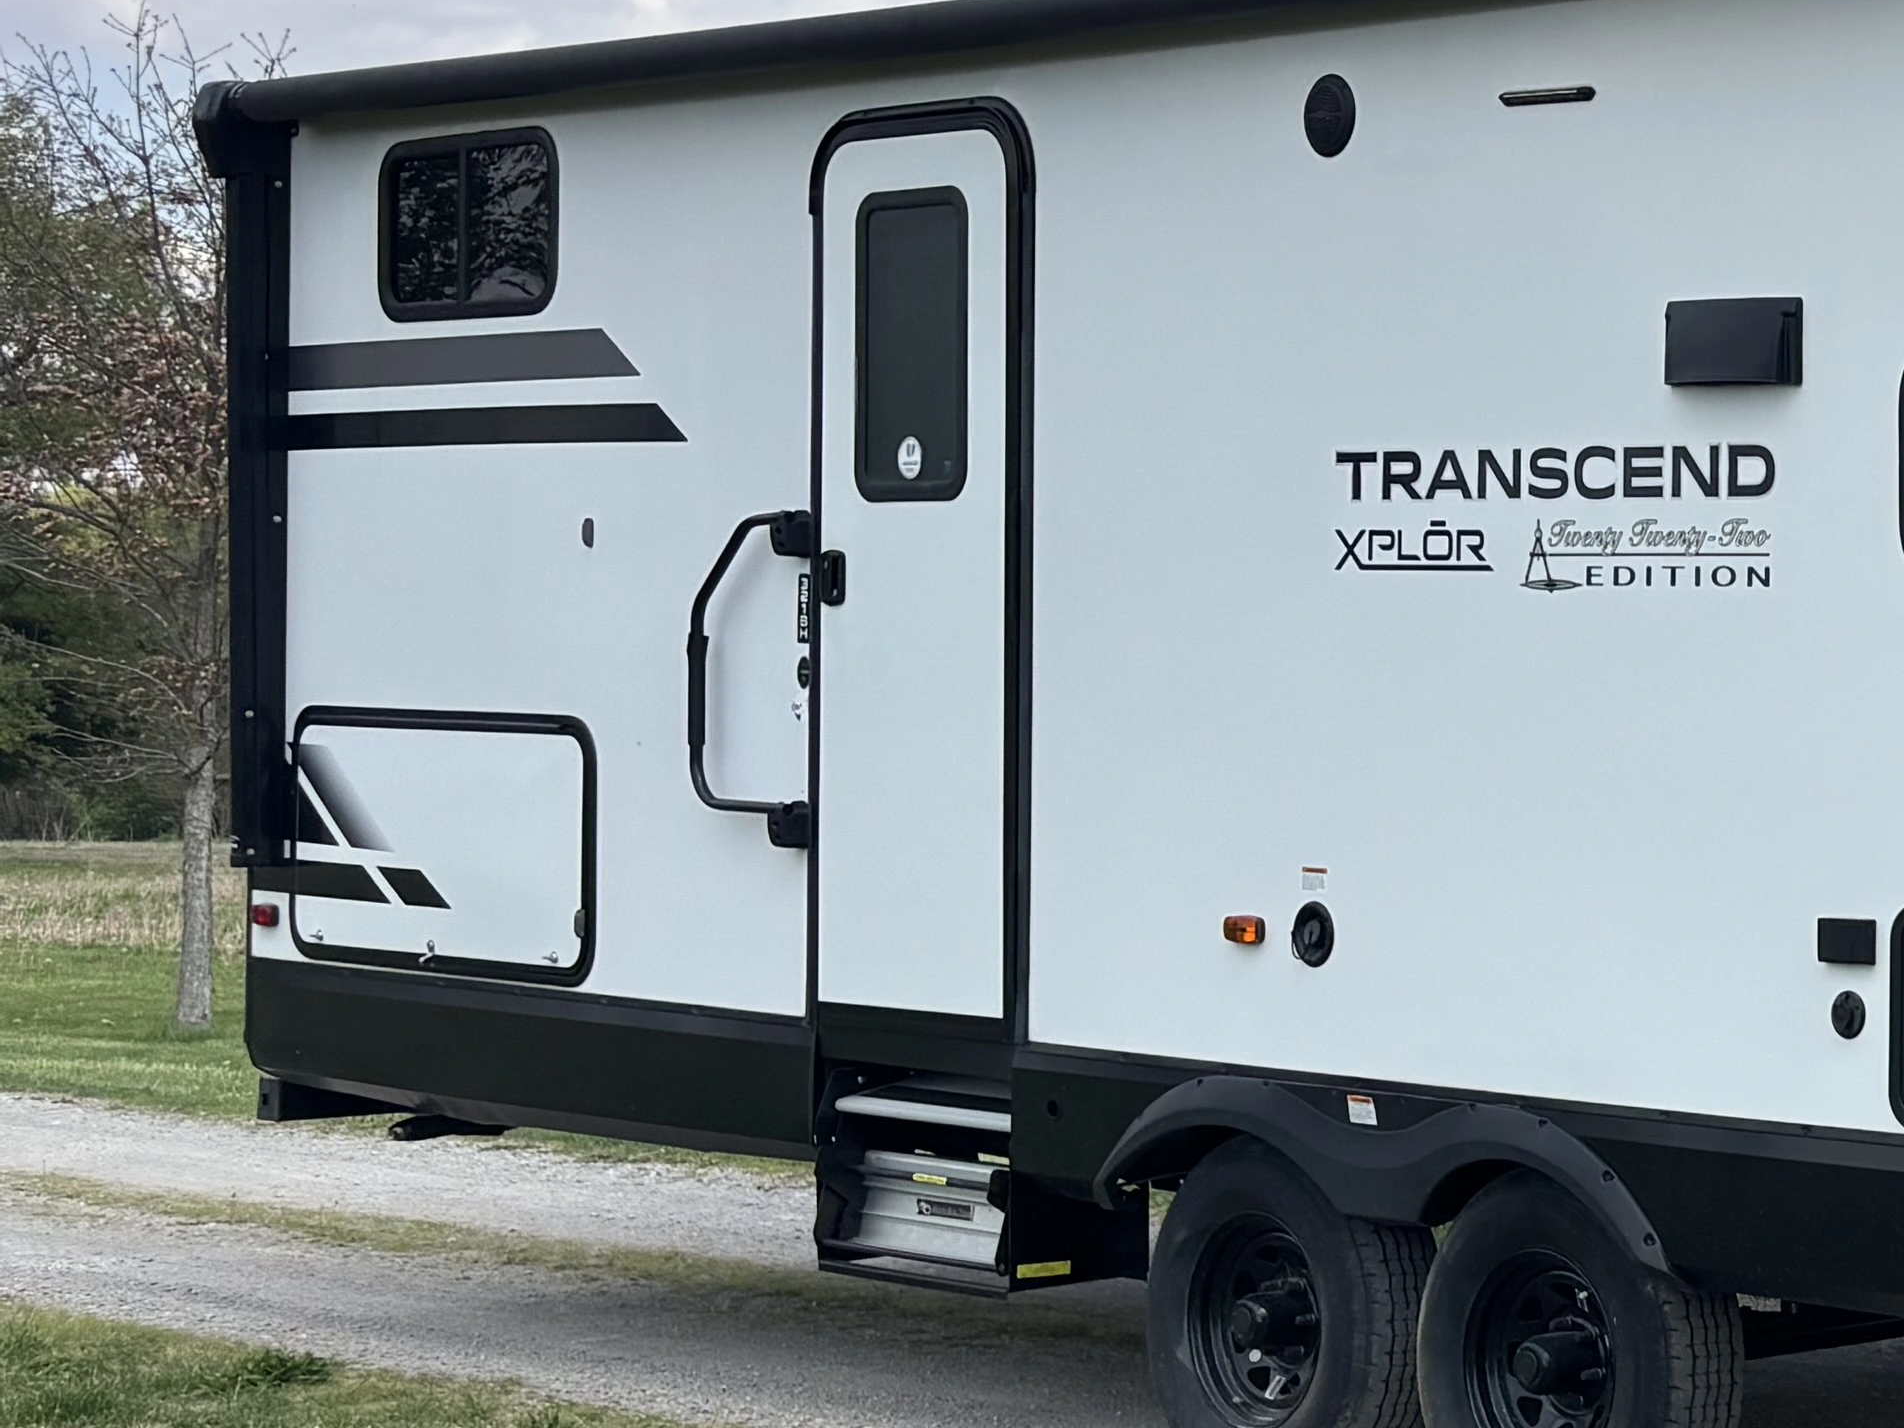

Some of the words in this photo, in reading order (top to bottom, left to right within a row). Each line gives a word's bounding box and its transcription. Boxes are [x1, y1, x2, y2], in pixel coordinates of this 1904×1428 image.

[1334, 444, 1776, 501] TRANSCEND
[1548, 519, 1624, 556] Twenty
[1585, 565, 1771, 587] EDITION
